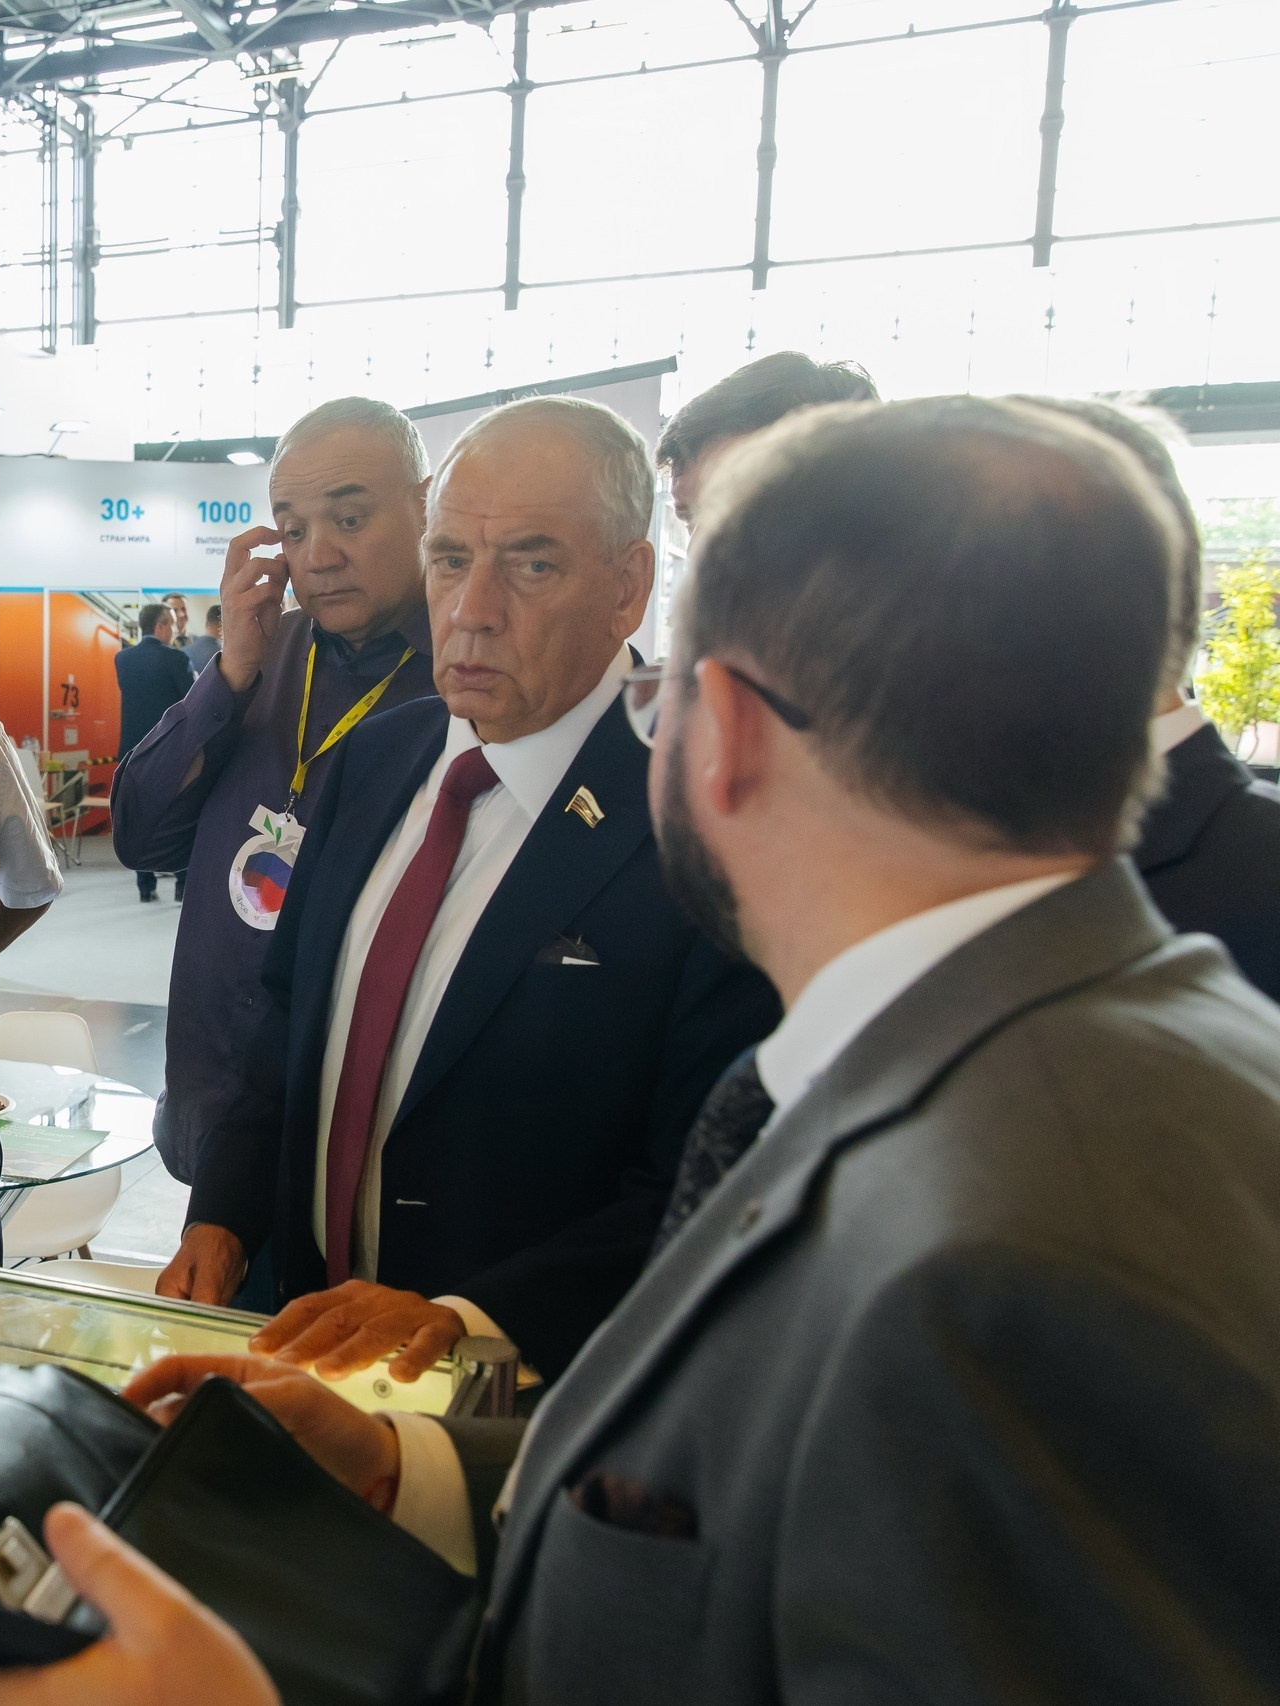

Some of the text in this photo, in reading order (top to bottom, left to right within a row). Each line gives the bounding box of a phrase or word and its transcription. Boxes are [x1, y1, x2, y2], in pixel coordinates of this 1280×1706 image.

[100, 498, 145, 520] 30+
[197, 500, 252, 523] 1000
[100, 534, 150, 543] СТРАН МИРА
[195, 536, 230, 545] ВЫПОЛН
[61, 683, 79, 708] 73
